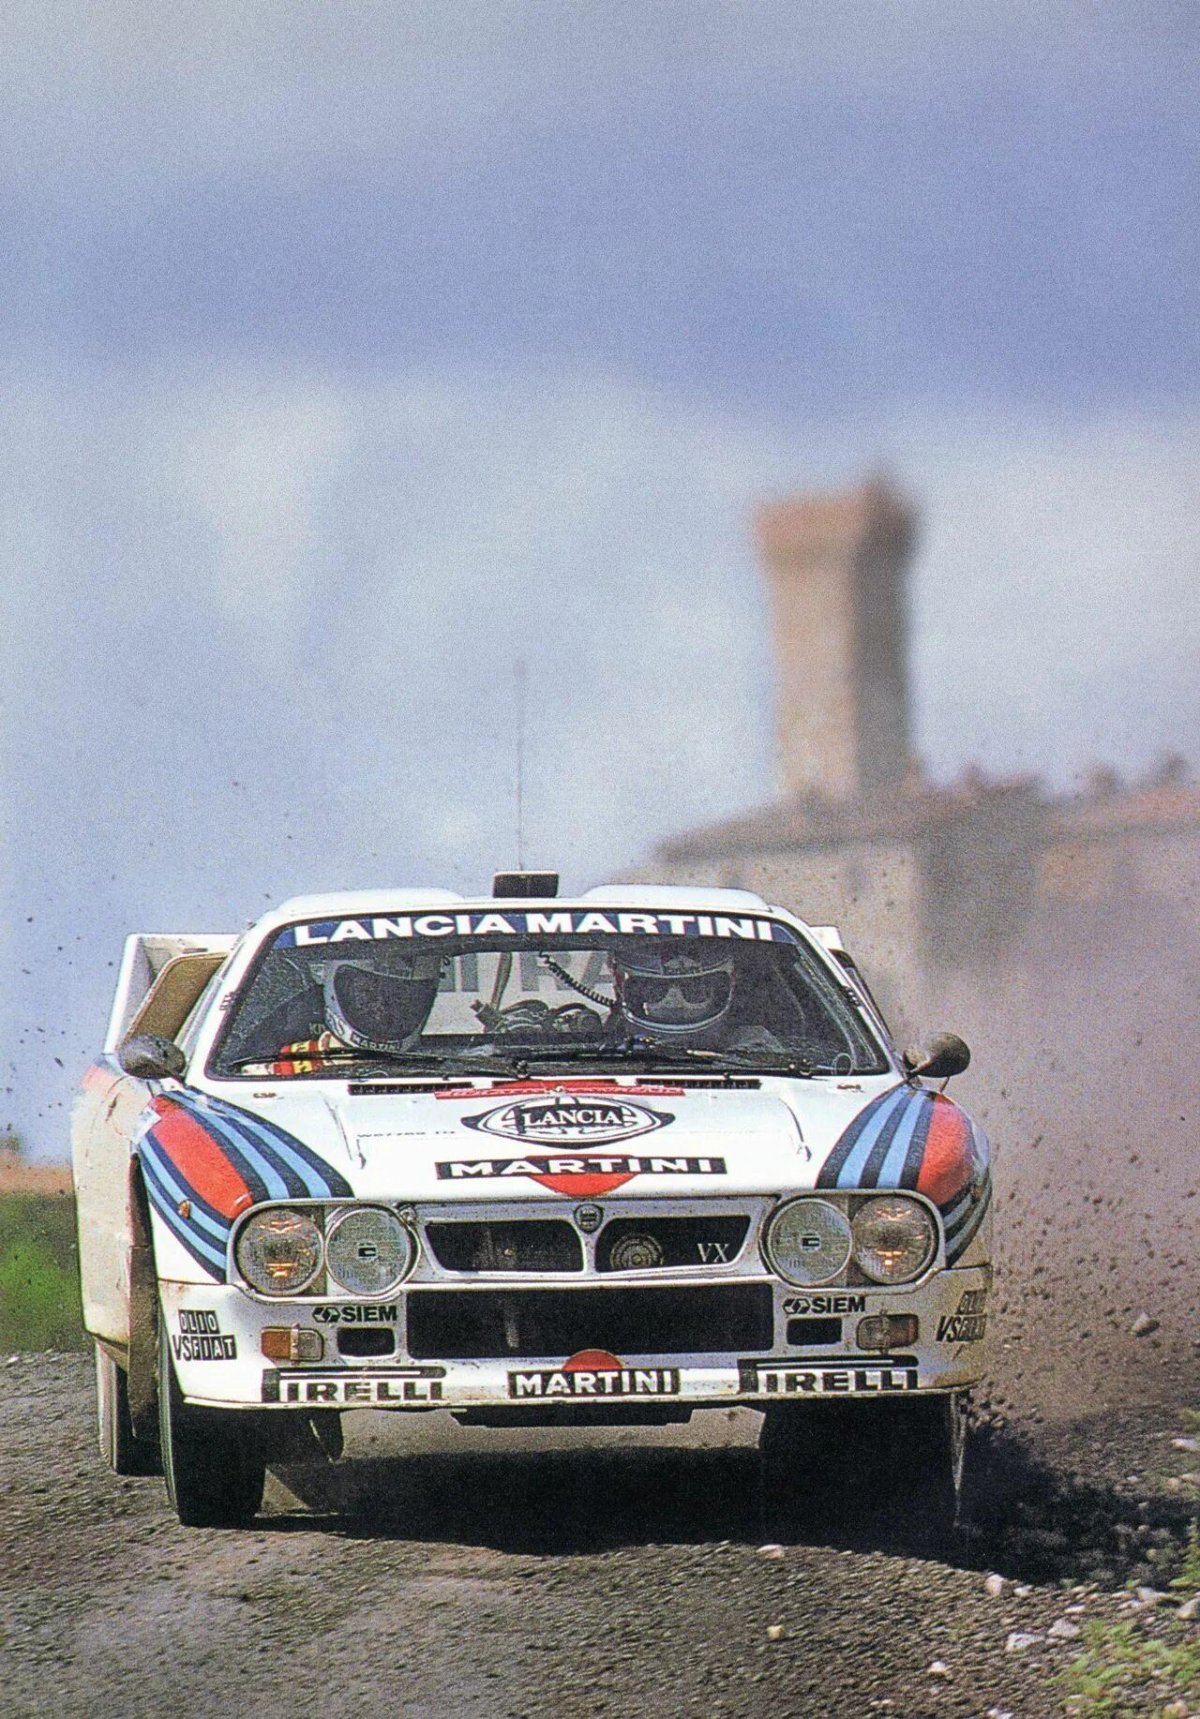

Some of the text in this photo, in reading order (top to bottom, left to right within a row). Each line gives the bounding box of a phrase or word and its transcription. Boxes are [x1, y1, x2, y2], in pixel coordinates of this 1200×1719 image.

[295, 912, 773, 946] LANCIA MARTINI
[522, 1108, 622, 1127] LANCIA
[449, 1157, 712, 1178] MARTINI
[697, 1242, 731, 1263] VX
[341, 1305, 398, 1323] SIEM
[809, 1296, 866, 1314] SIEM
[262, 1366, 446, 1401] PIRELLI
[514, 1370, 672, 1396] MARTINI
[737, 1355, 919, 1394] PIRELLI
